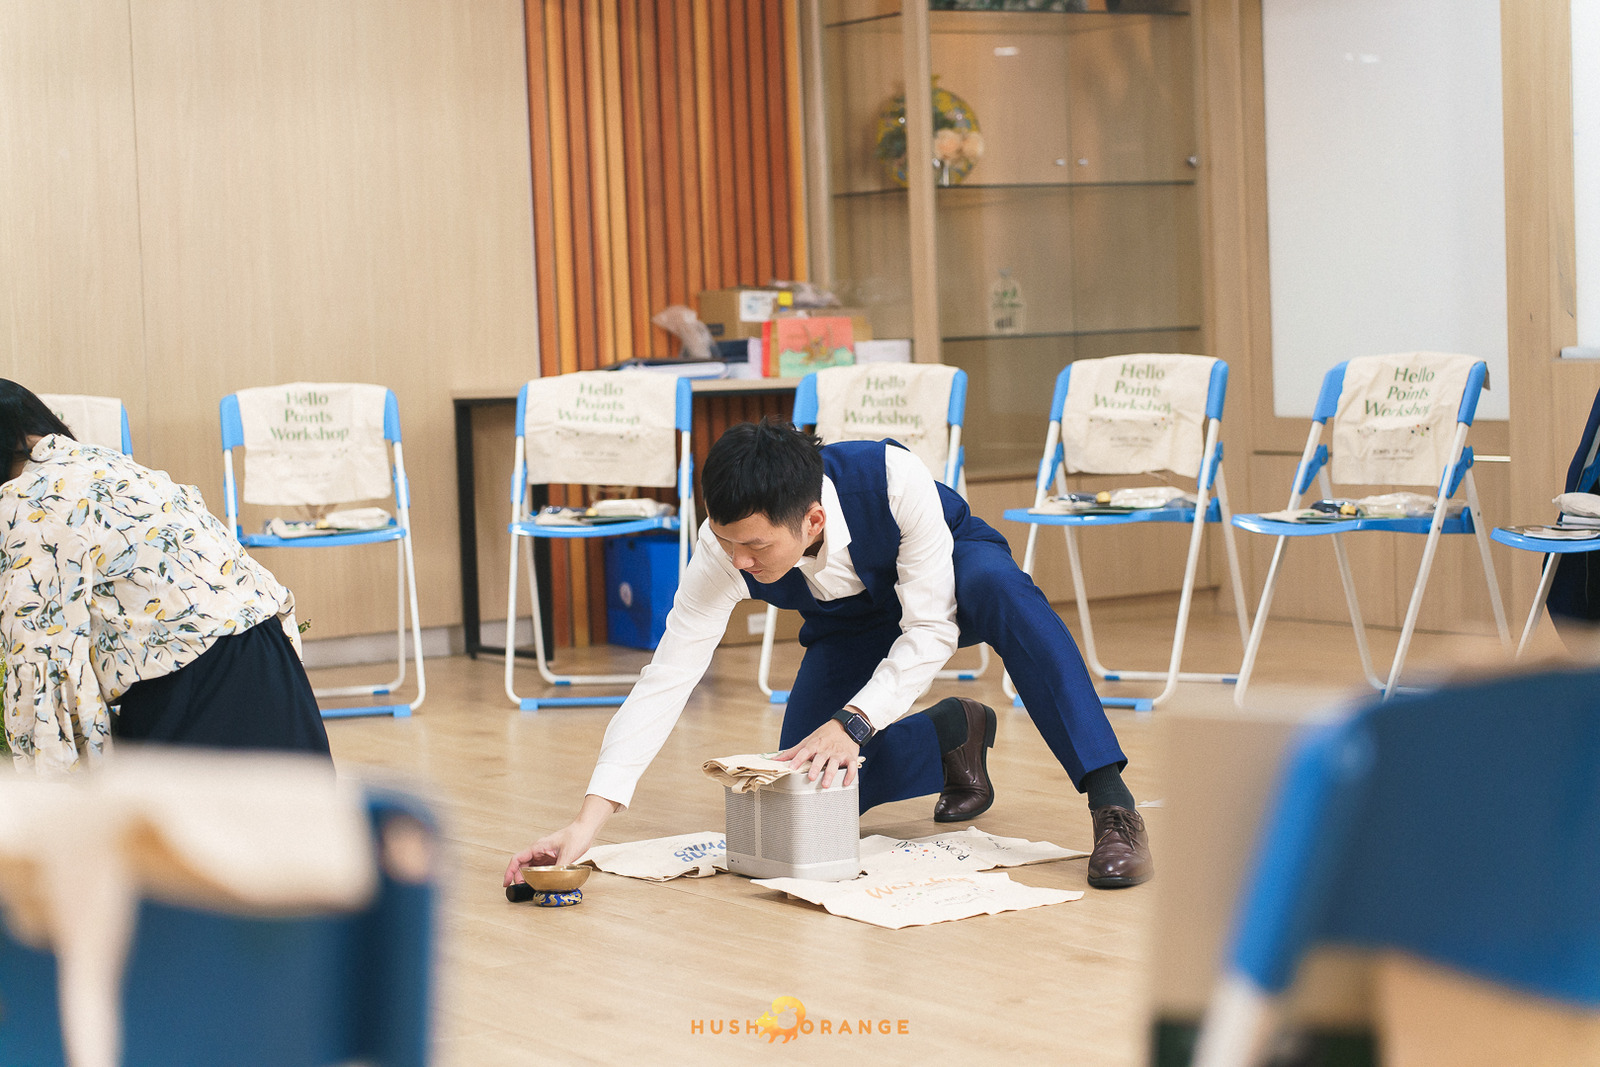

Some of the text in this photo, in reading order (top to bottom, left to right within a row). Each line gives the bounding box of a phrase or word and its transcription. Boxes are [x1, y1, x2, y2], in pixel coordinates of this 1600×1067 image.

[1121, 363, 1165, 379] Hello
[1394, 367, 1435, 383] Hello
[580, 382, 623, 396] Hello
[866, 375, 906, 390] Hello
[285, 391, 329, 406] Hello
[576, 397, 624, 410] Points
[861, 394, 908, 407] Points
[284, 409, 333, 423] Points
[558, 408, 641, 425] Workshop
[844, 409, 922, 429] Workshop
[270, 426, 349, 441] Workshop
